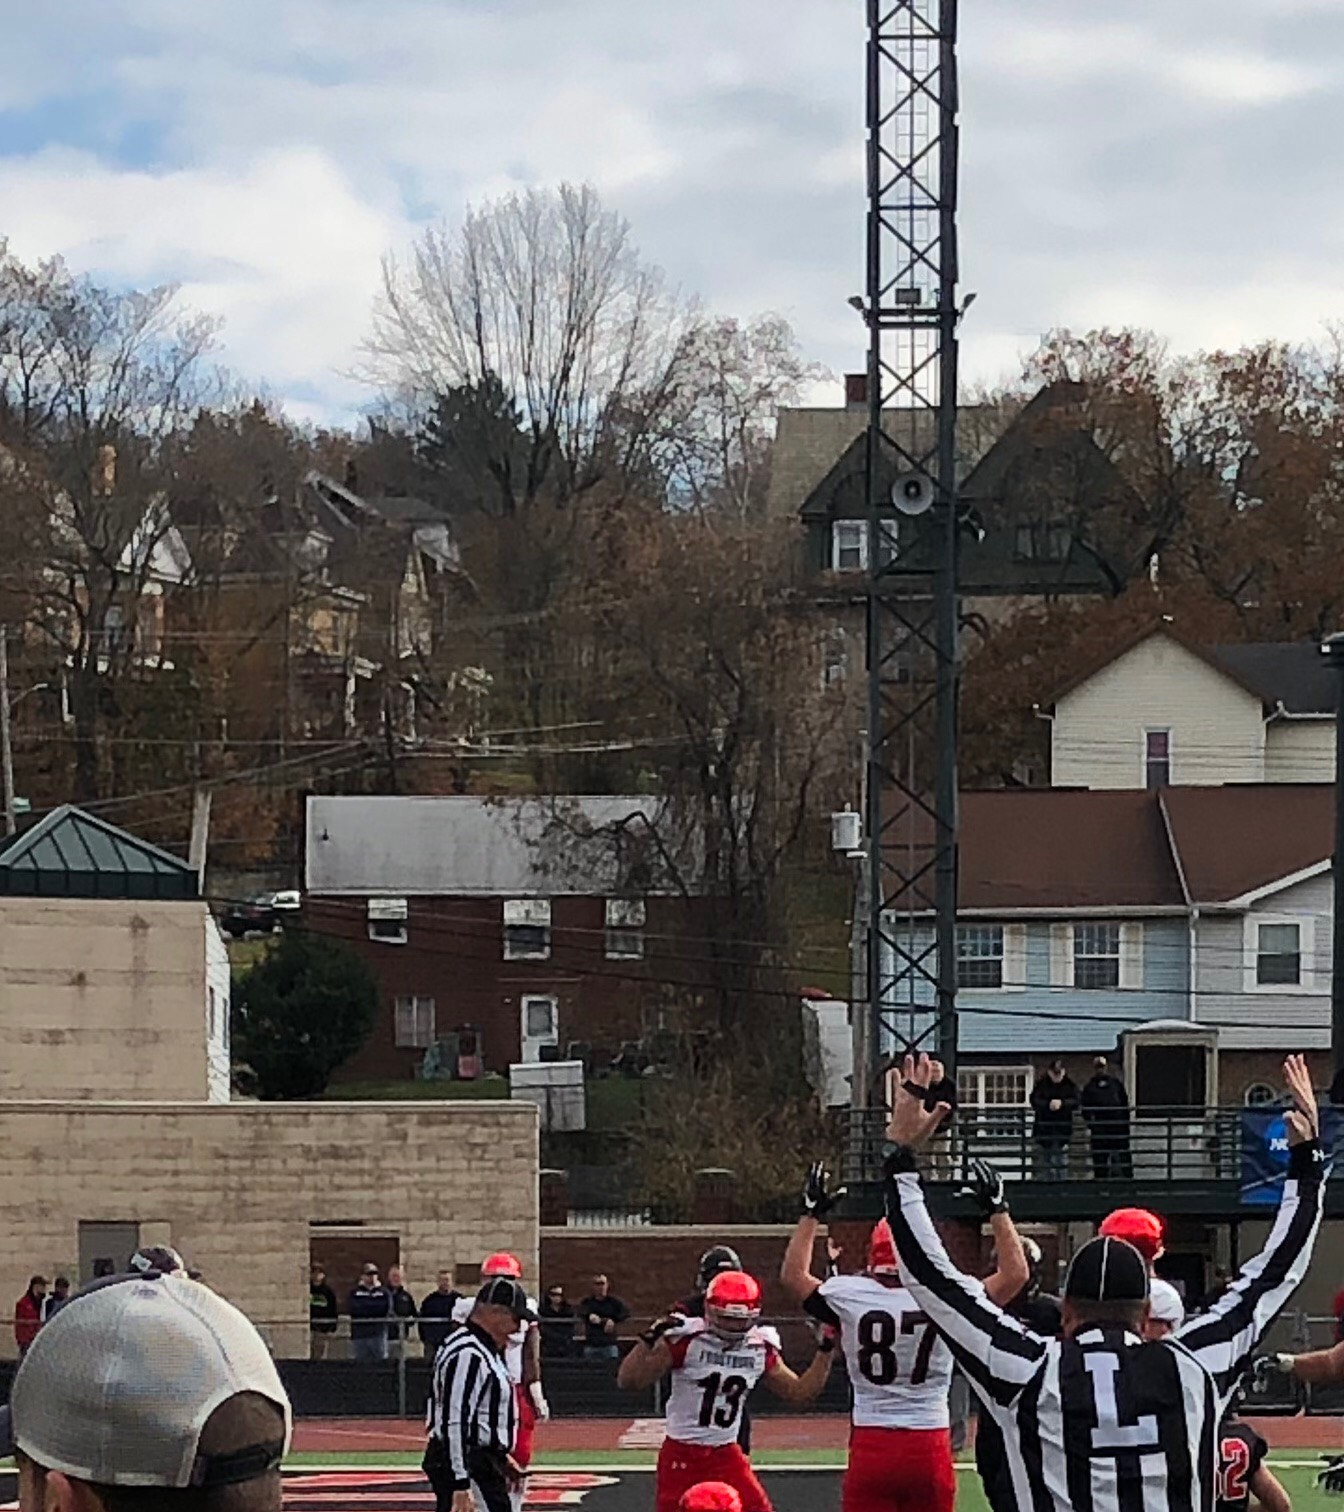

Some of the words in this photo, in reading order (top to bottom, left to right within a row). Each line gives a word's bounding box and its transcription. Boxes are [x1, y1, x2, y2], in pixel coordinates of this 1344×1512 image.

[857, 1308, 940, 1386] 87
[696, 1371, 748, 1429] 13
[1083, 1352, 1160, 1449] L
